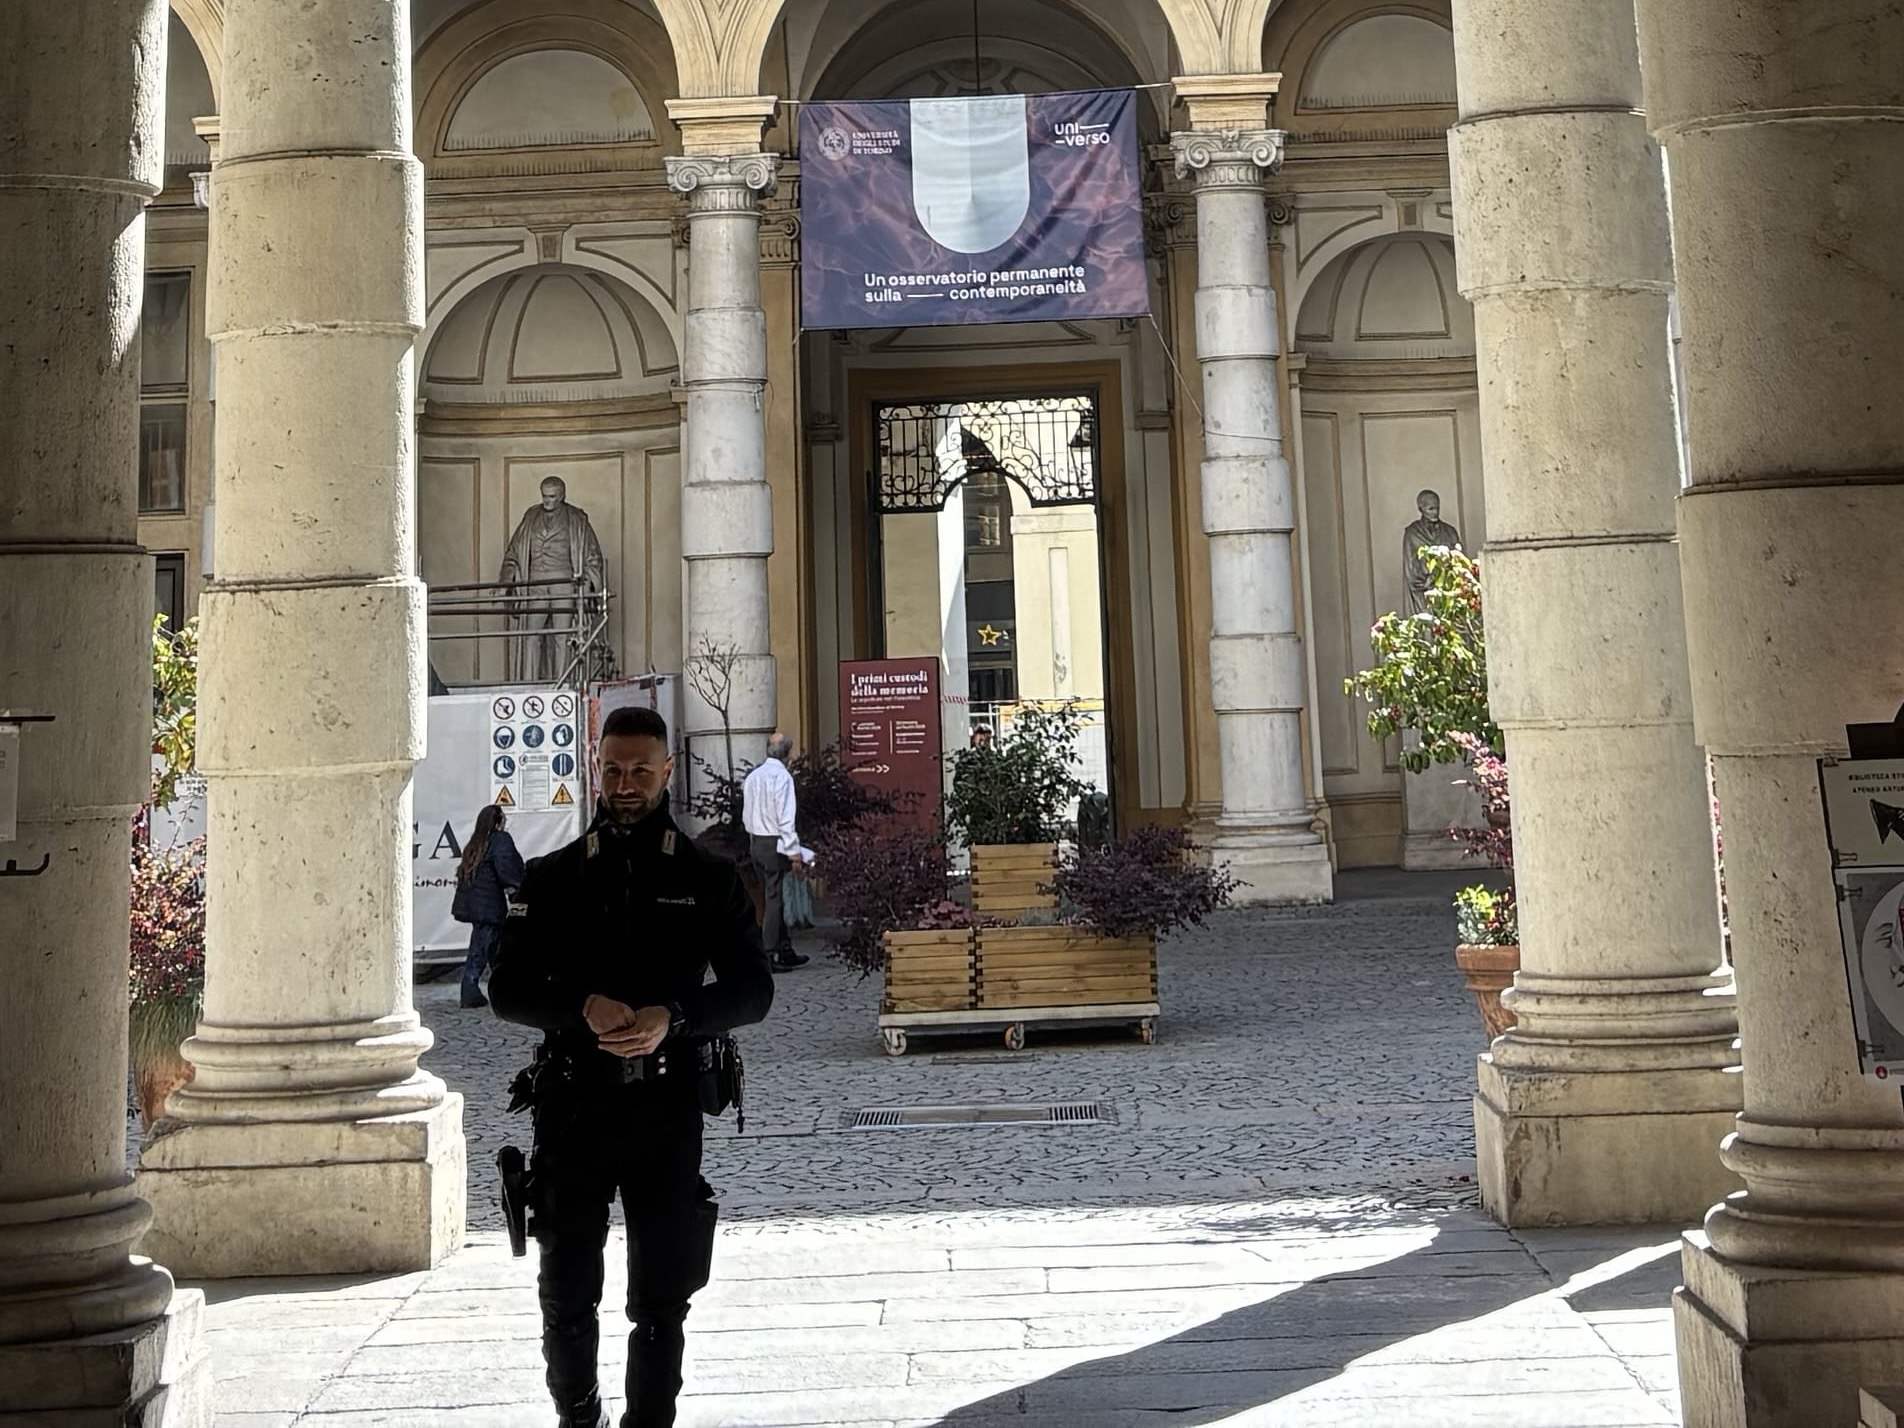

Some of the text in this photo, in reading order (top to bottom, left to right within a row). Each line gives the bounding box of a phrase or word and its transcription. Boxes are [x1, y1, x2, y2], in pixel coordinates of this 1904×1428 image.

[864, 264, 1085, 287] Un osservatorio permanente
[864, 279, 1086, 302] sulla contemporaneità
[857, 672, 887, 687] primi
[889, 670, 928, 683] custodi
[851, 684, 877, 696] della
